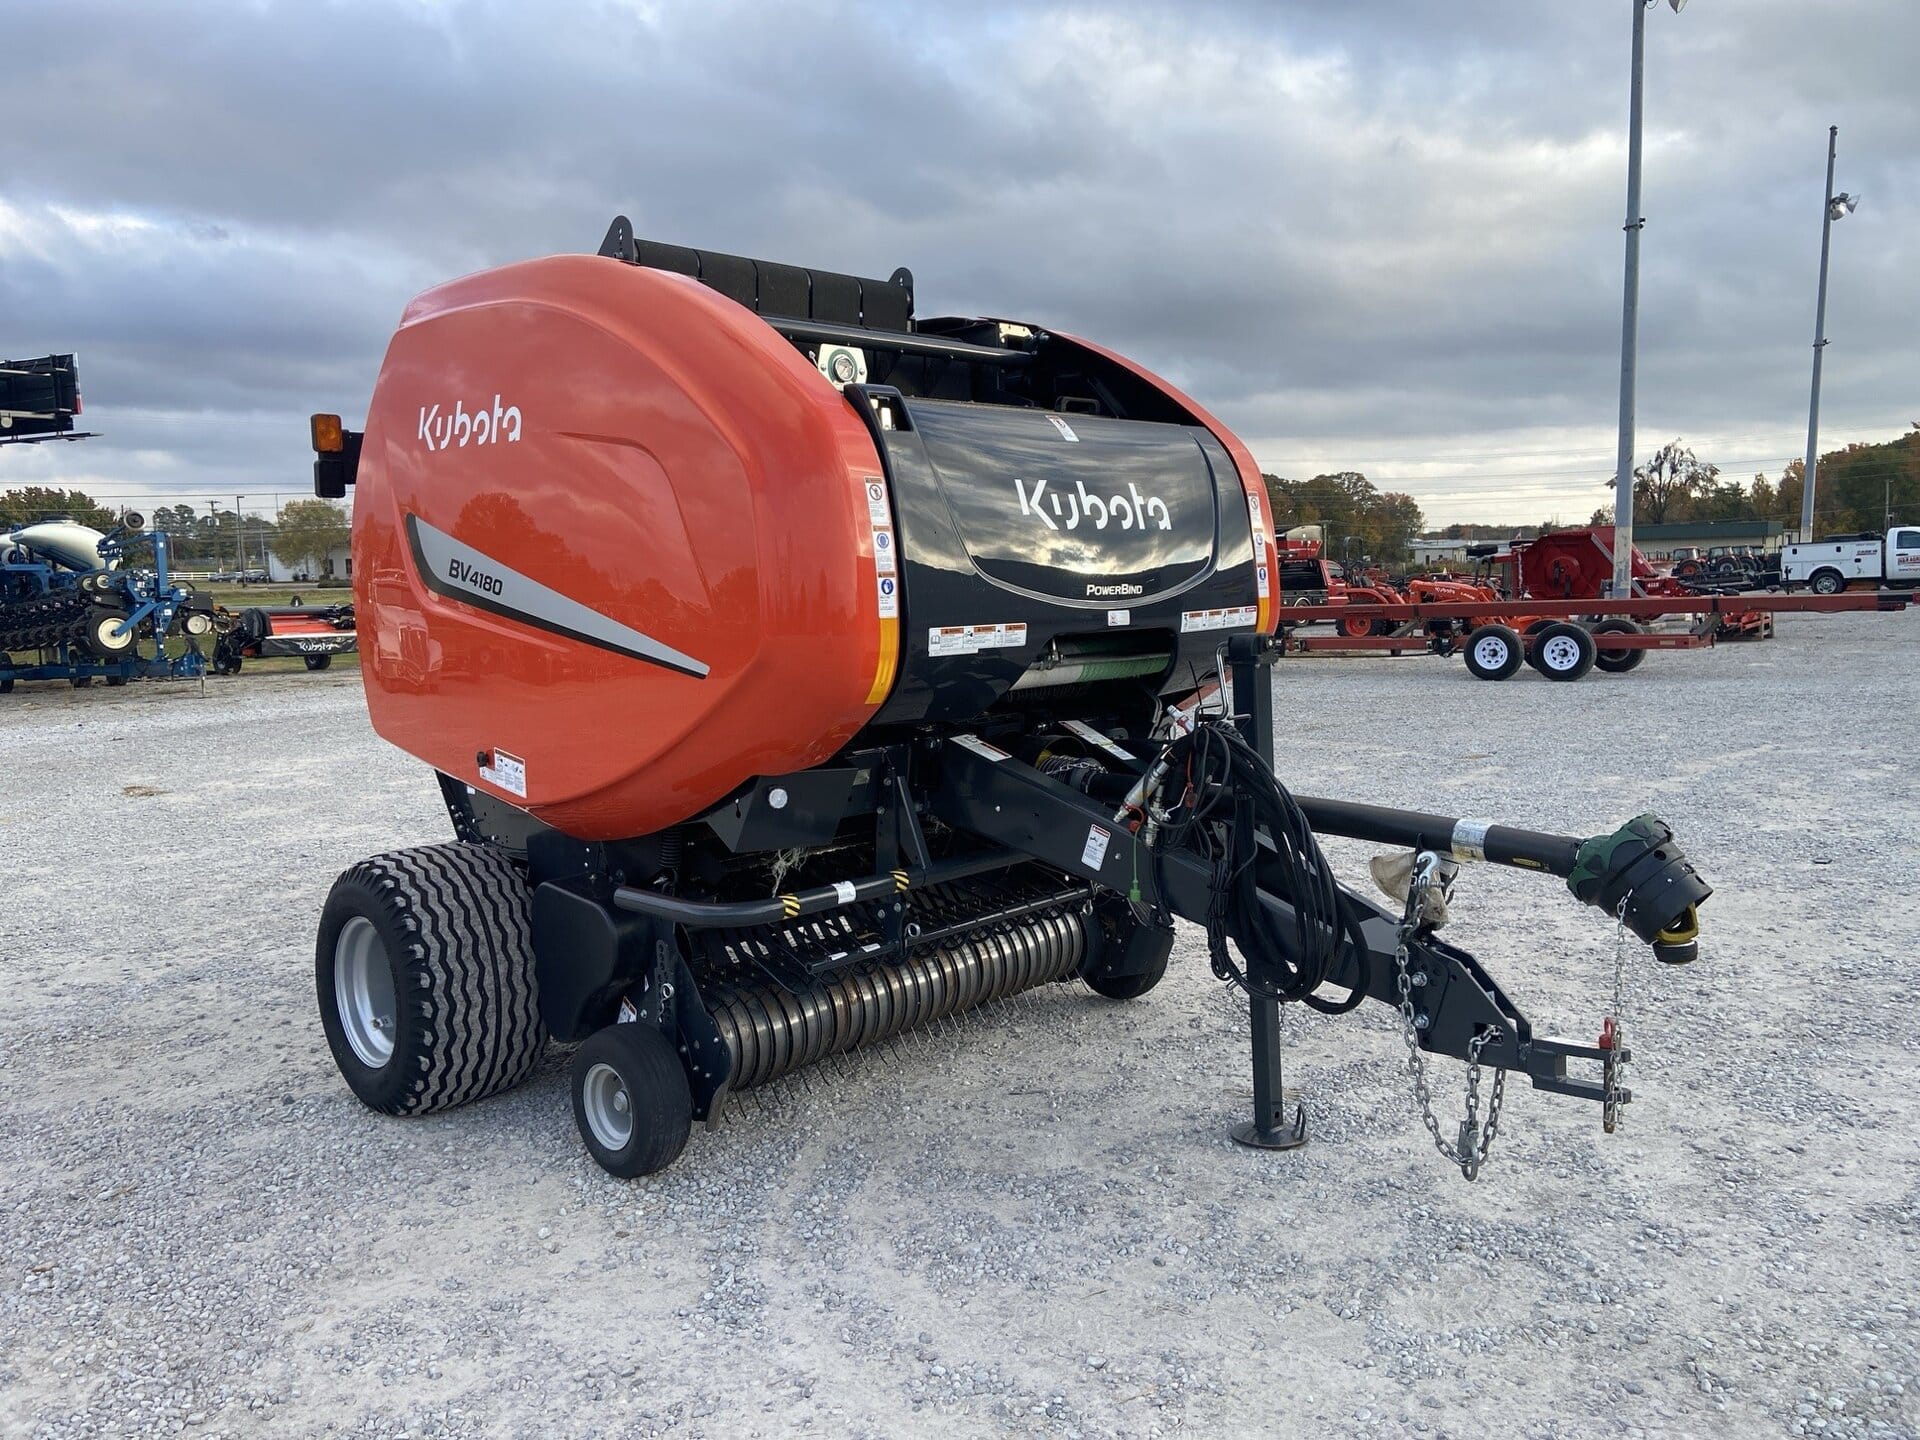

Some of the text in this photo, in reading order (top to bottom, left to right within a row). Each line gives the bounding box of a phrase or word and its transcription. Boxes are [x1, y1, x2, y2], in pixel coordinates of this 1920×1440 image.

[418, 394, 522, 451] Kubota
[1014, 479, 1172, 531] Kubota
[449, 558, 503, 596] BV4180
